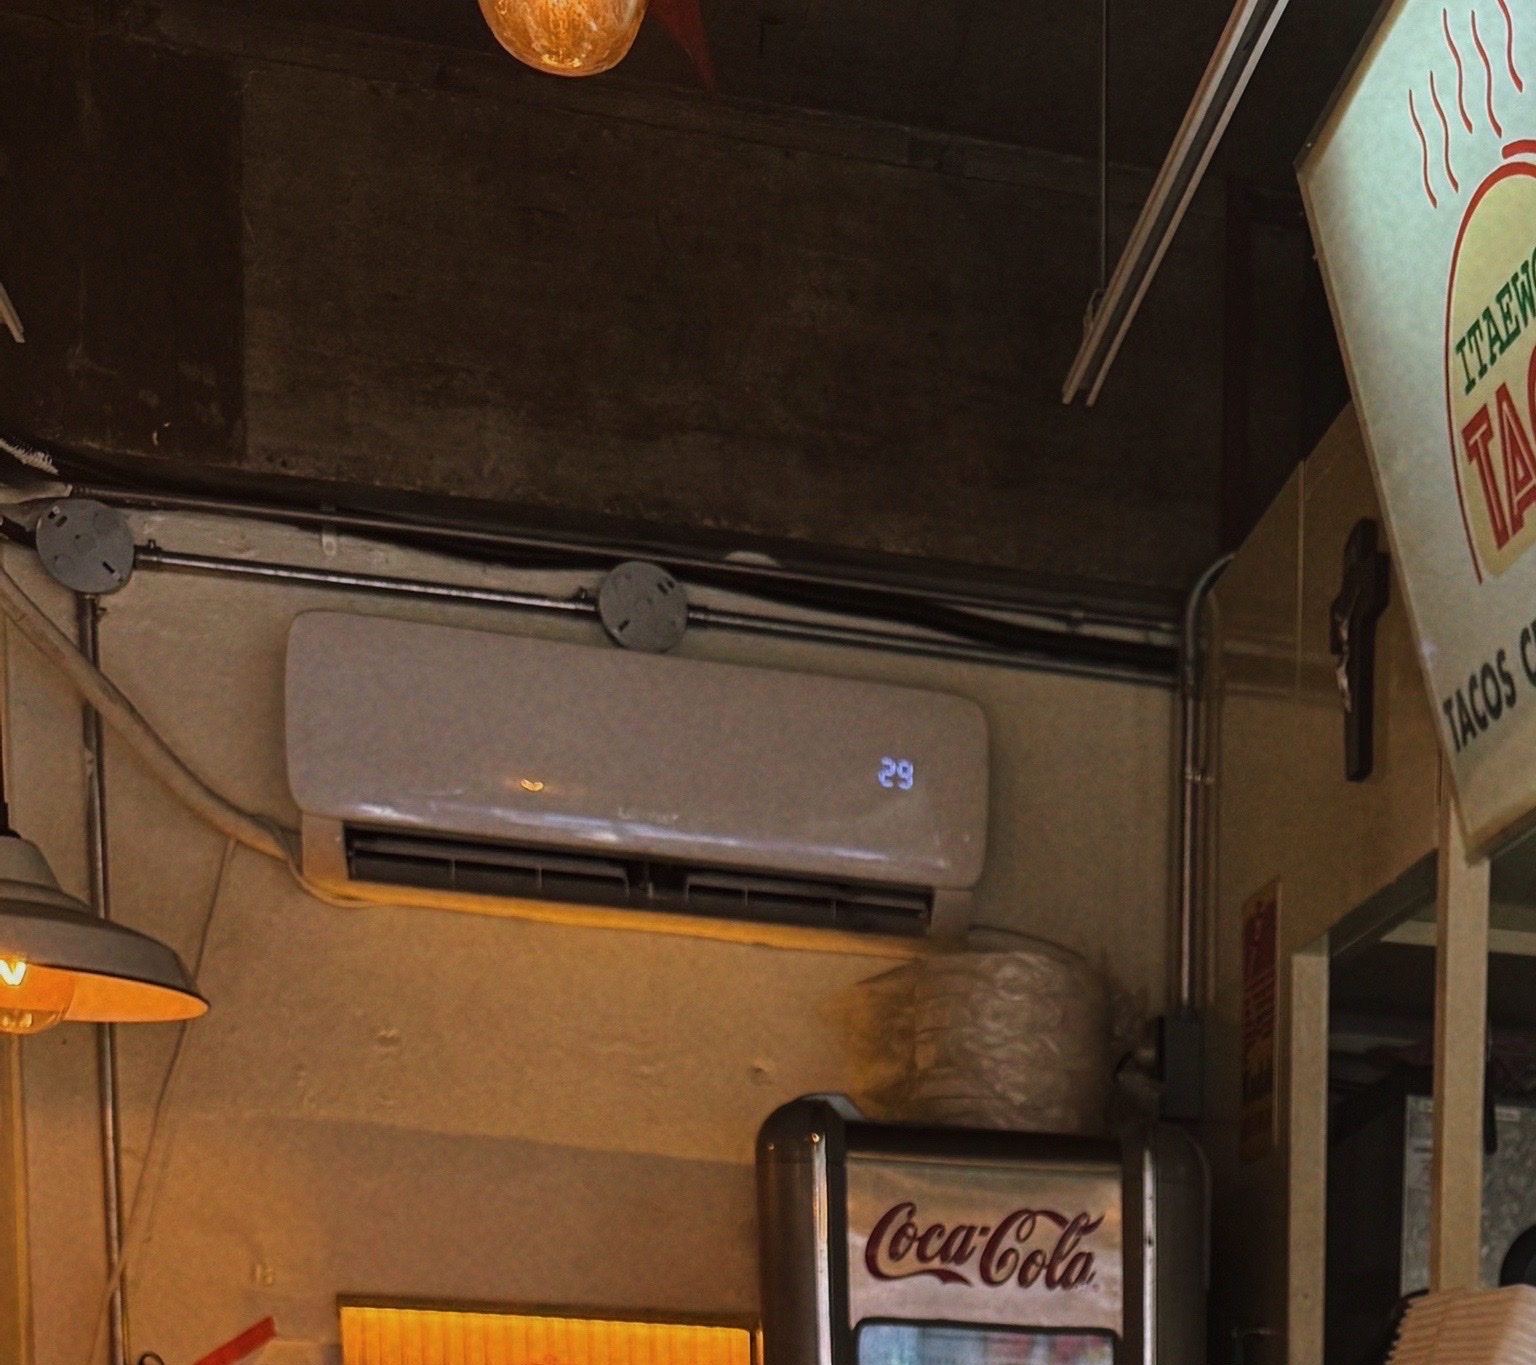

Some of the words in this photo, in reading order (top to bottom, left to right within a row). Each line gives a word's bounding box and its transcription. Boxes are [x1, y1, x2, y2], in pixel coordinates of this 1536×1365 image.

[1442, 667, 1517, 753] TACOS
[878, 757, 914, 790] 29
[864, 1201, 1105, 1290] Coca-Cola
